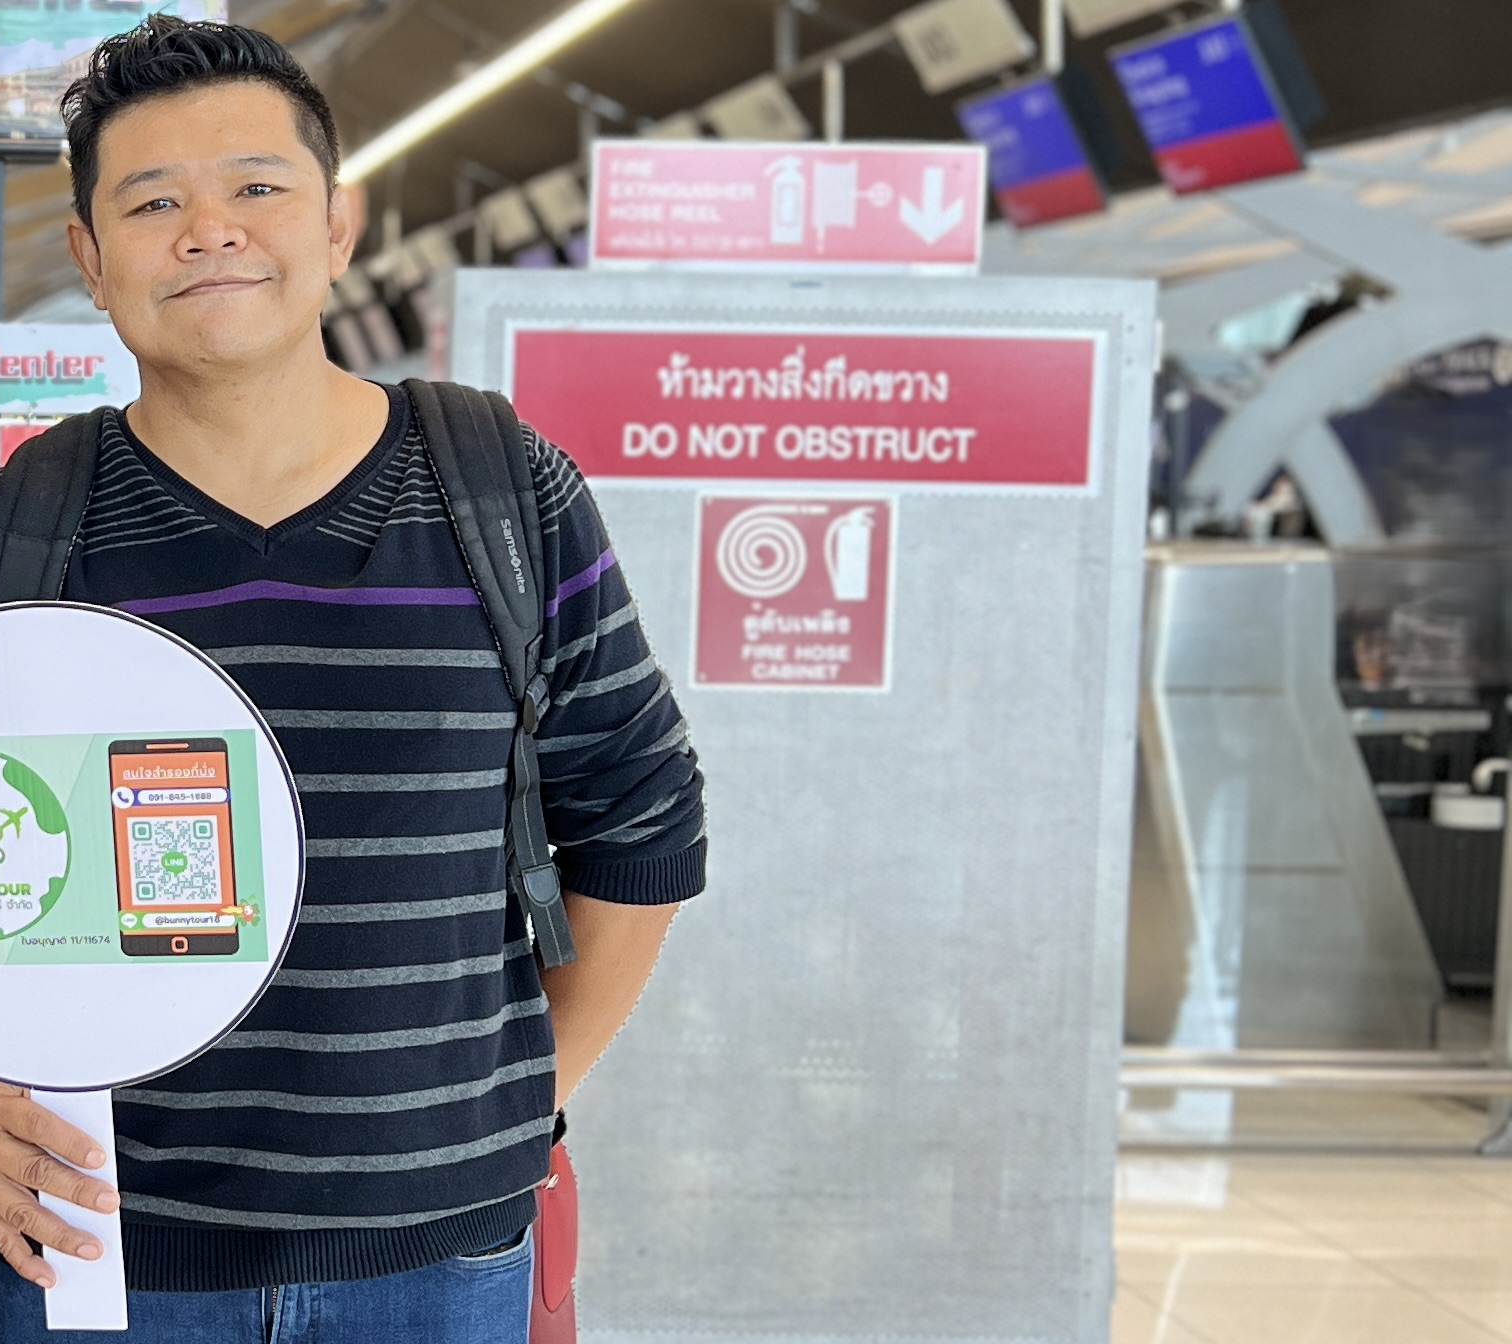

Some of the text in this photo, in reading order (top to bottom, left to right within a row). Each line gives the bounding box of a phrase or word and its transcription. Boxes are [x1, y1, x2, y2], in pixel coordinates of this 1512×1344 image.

[609, 159, 654, 178] FIRE
[608, 181, 757, 201] EXTINGUISHER
[607, 203, 723, 224] HOSE REEL
[656, 342, 951, 404] ห้ามวางสิ่งกีดขวาง
[622, 422, 978, 464] DO NOT OBSTRUCT
[499, 517, 527, 594] Samsonite
[740, 643, 852, 664] FIRE HOSE
[750, 661, 842, 681] CABINET
[164, 857, 185, 868] LINE
